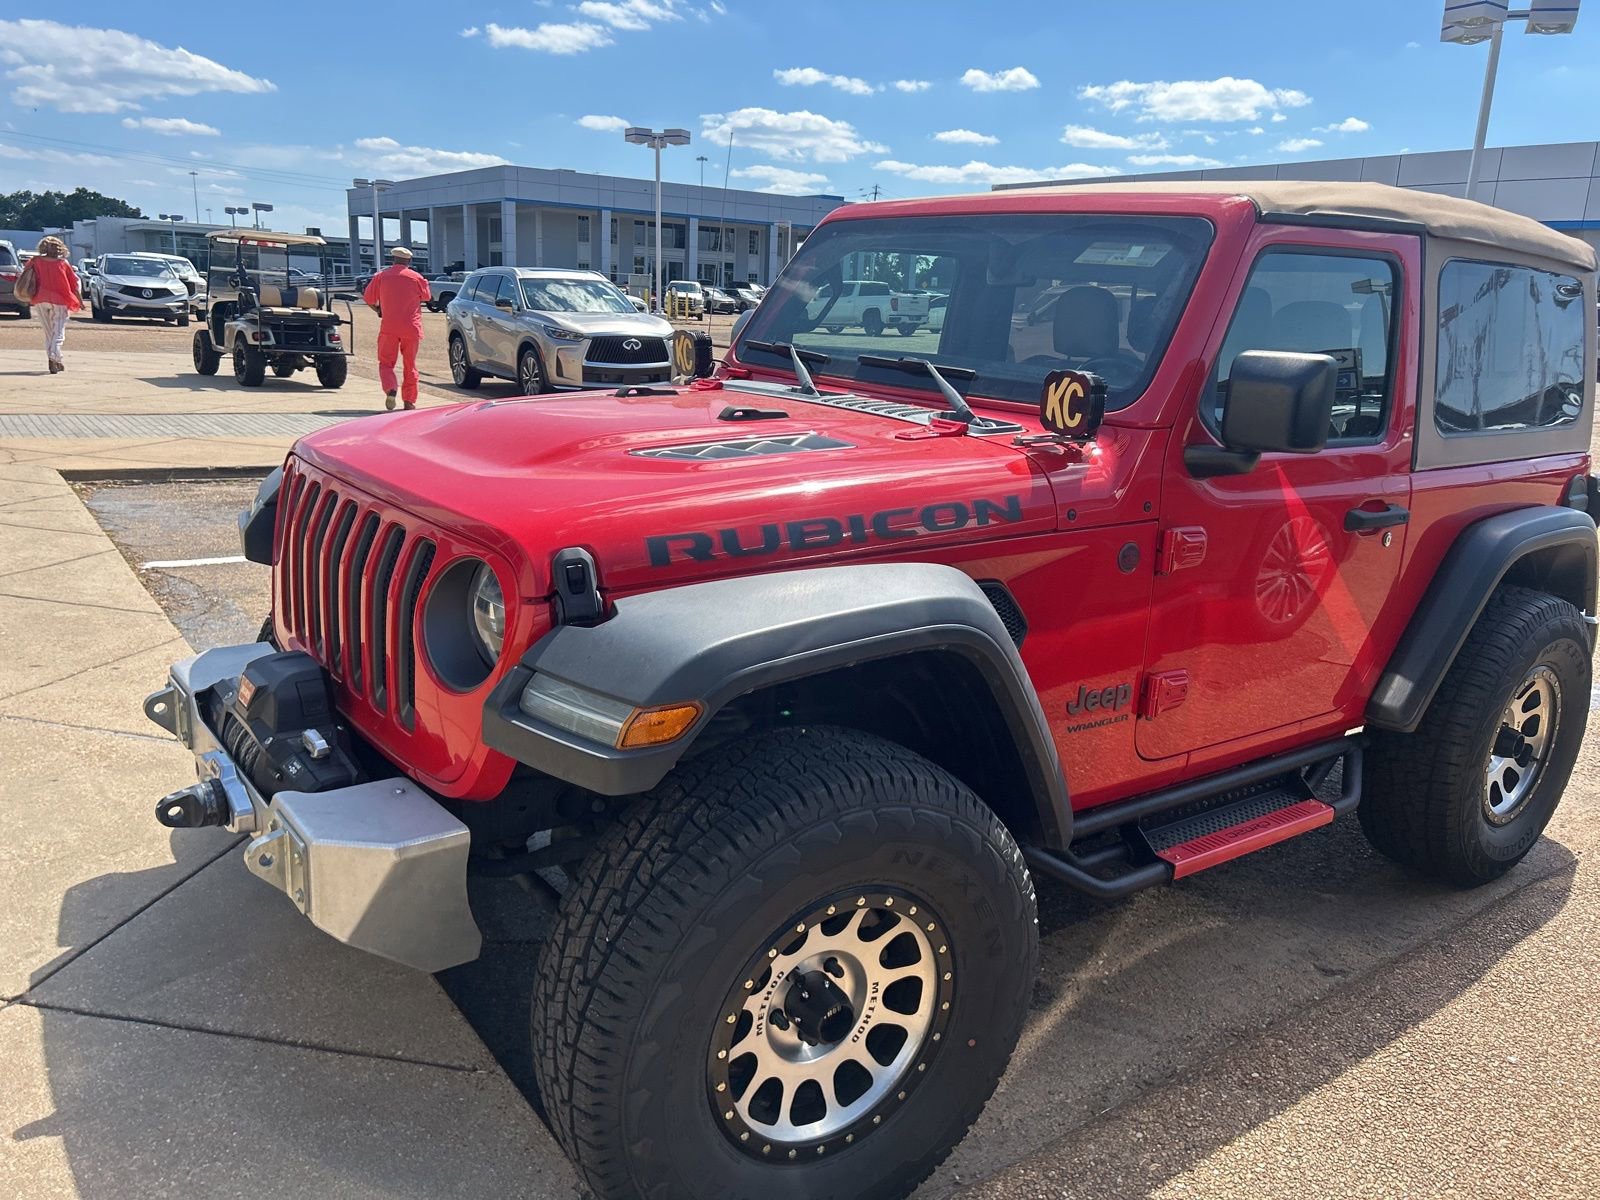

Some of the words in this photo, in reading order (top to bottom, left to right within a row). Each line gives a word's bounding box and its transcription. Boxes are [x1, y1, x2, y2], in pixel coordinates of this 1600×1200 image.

[675, 334, 693, 372] KC
[1045, 377, 1084, 429] KC
[645, 495, 1025, 568] RUBICON
[1066, 682, 1132, 717] Jeep
[1066, 713, 1129, 734] WRANGLER
[756, 970, 785, 1037] METHOD
[851, 981, 880, 1043] METHOD
